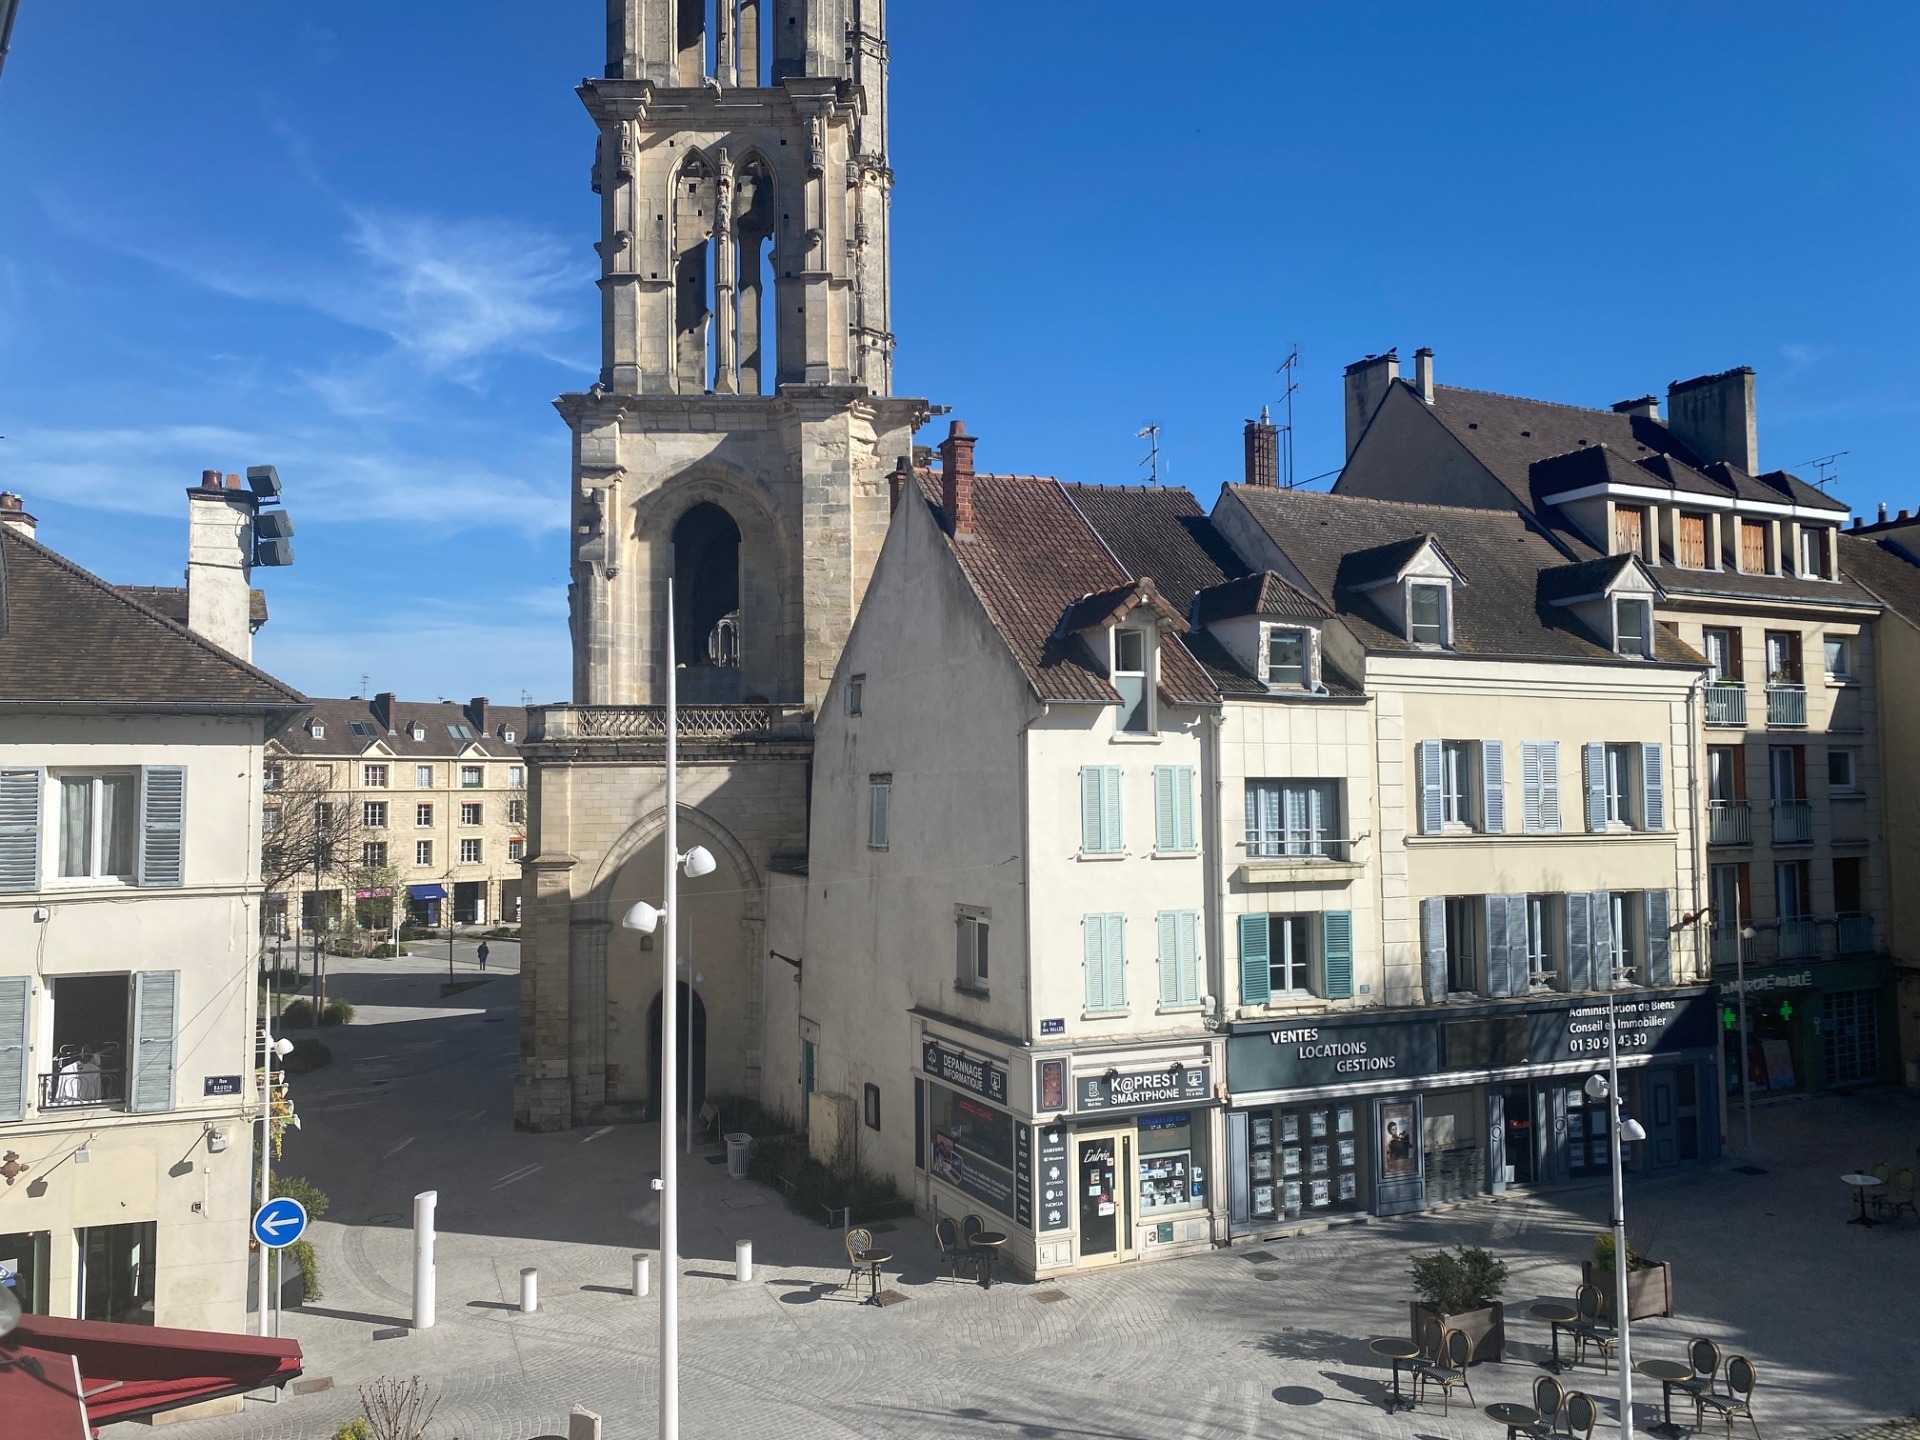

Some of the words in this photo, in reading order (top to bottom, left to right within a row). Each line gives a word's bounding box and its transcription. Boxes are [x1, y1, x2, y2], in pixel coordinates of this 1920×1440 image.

[1569, 1003, 1636, 1017] Administation
[1569, 1020, 1603, 1033] Conseil
[1617, 1016, 1667, 1029] Immobilier
[1271, 1028, 1319, 1044] VENTES
[1570, 1039, 1583, 1051] 01
[1586, 1038, 1600, 1050] 30
[1633, 1033, 1647, 1045] 30
[1299, 1041, 1367, 1059] LOCATIONS
[1337, 1056, 1396, 1073] GESTIONS
[943, 1067, 983, 1091] INFORMATIQUE
[1111, 1073, 1179, 1093] K@PREST
[1111, 1088, 1179, 1104] SMARTPHONE
[1084, 1147, 1110, 1163] Entrée
[1148, 1231, 1157, 1242] 3
